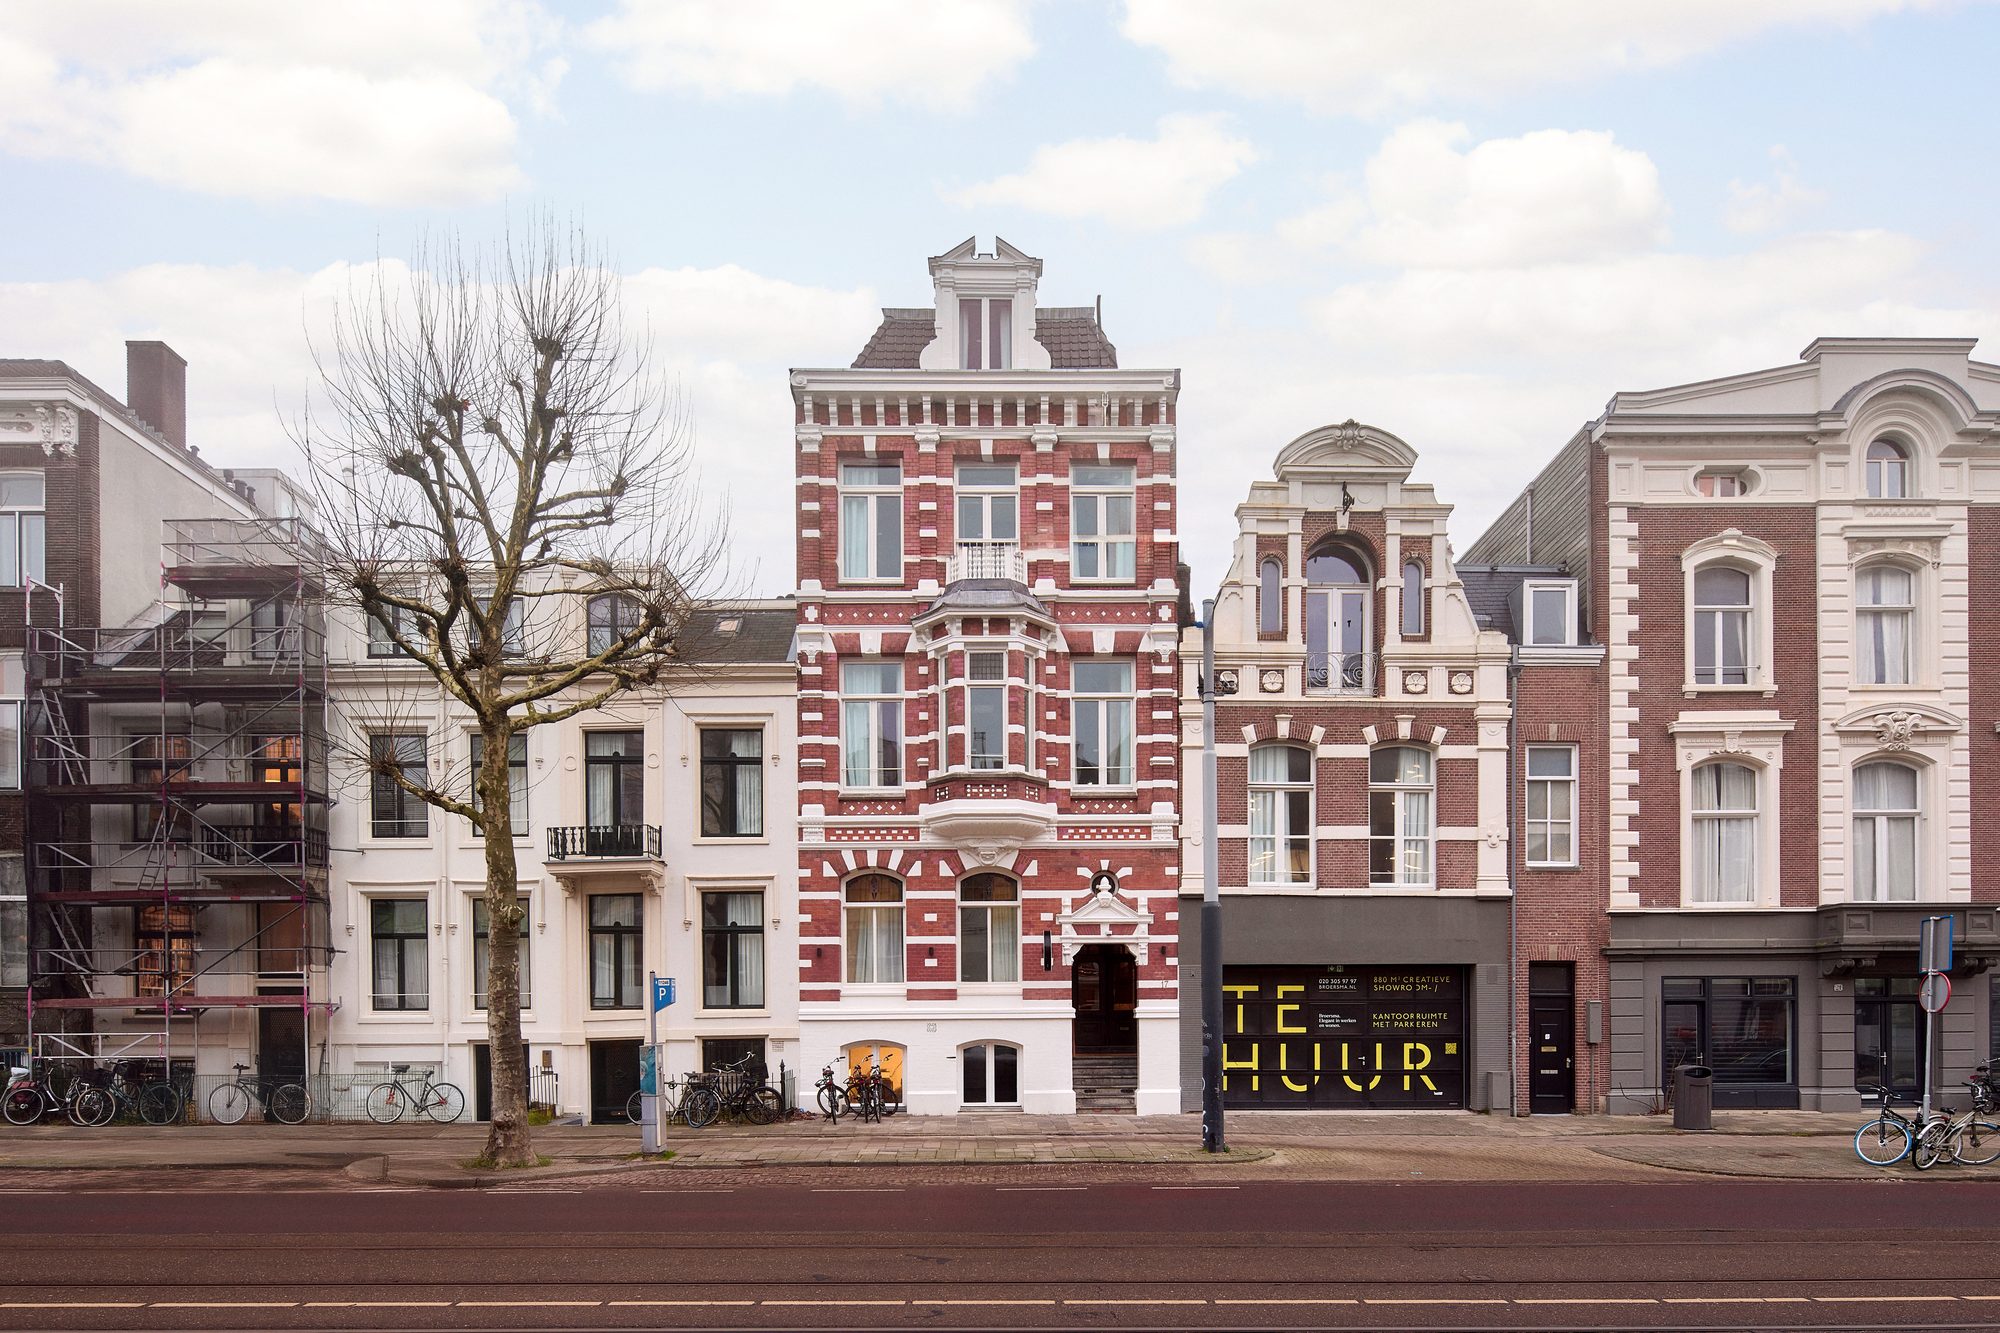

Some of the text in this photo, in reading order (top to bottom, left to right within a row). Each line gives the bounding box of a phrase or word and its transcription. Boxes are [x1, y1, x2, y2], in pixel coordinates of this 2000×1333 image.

[659, 987, 666, 1001] P
[1222, 985, 1307, 1033] TE
[1222, 1043, 1437, 1092] HUUR
